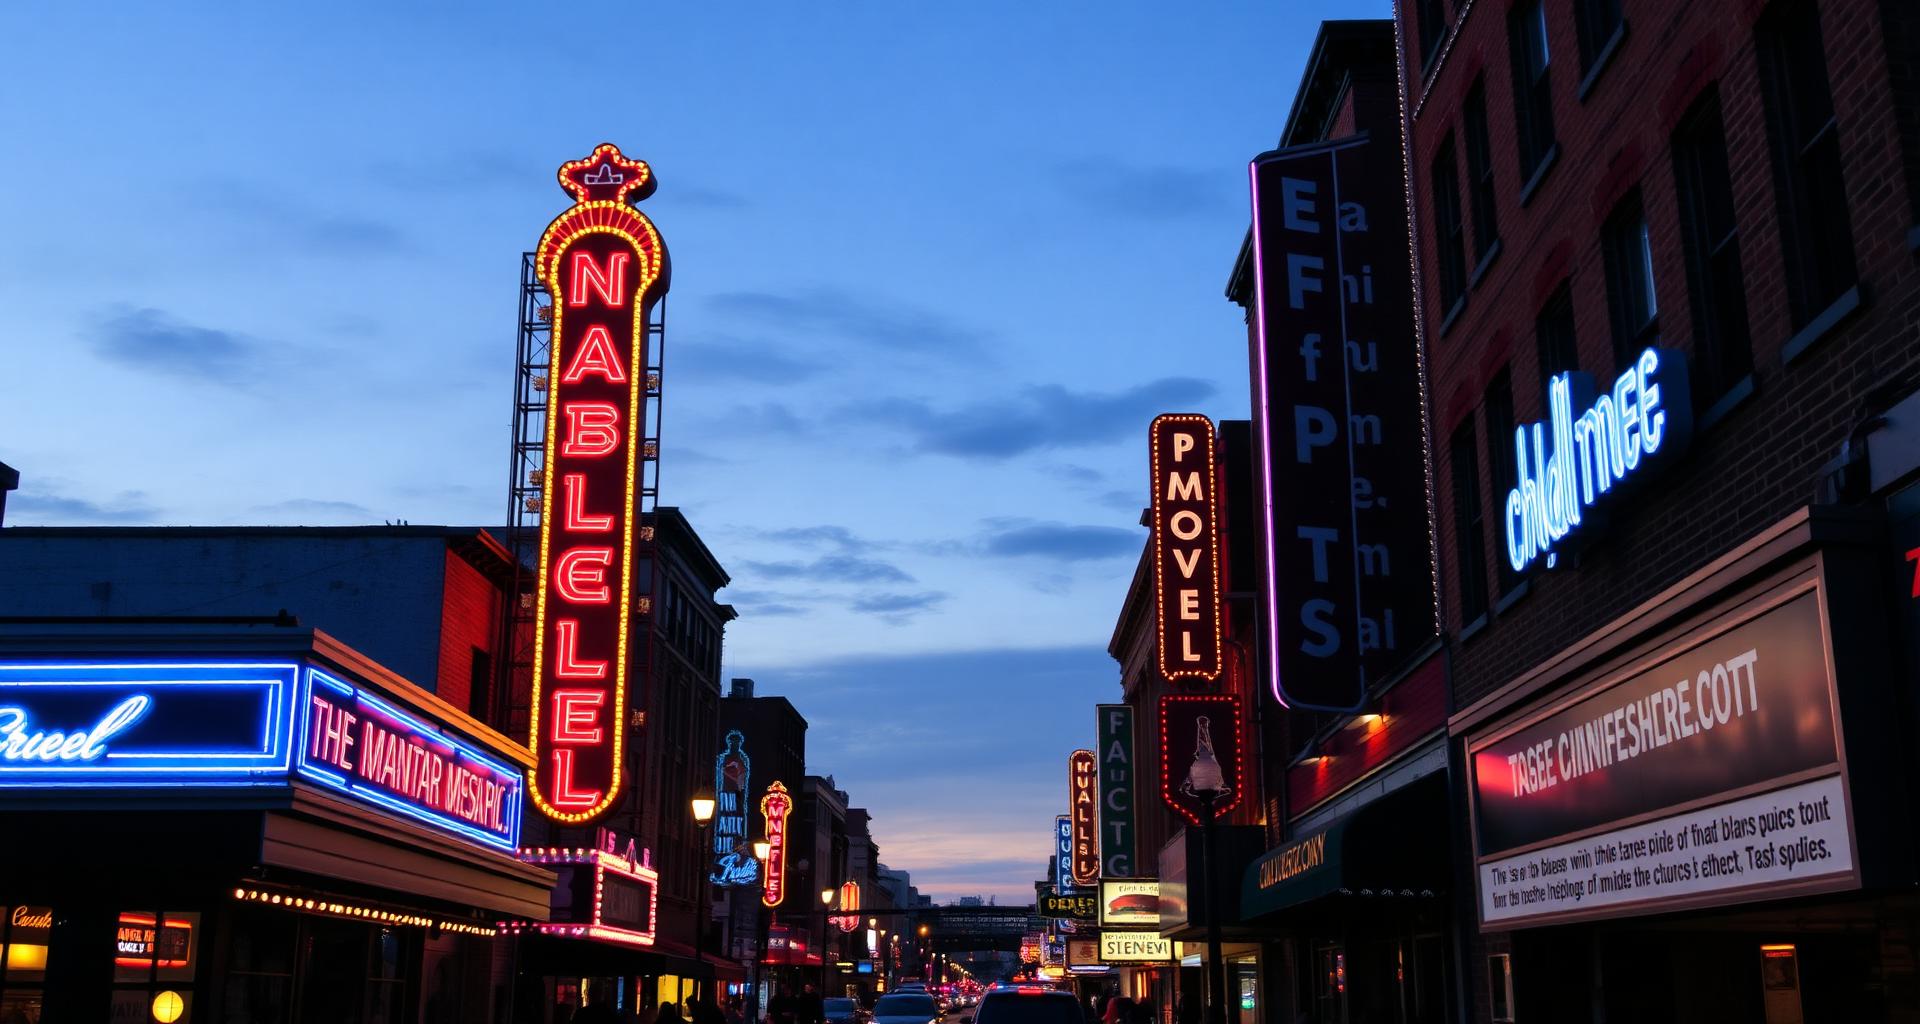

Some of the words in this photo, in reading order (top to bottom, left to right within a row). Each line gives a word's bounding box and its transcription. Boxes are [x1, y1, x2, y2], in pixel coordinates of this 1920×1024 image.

[554, 250, 629, 807] NABLELEL
[1166, 432, 1204, 662] PMOVEL
[313, 696, 357, 770] THE
[1634, 864, 1651, 887] the
